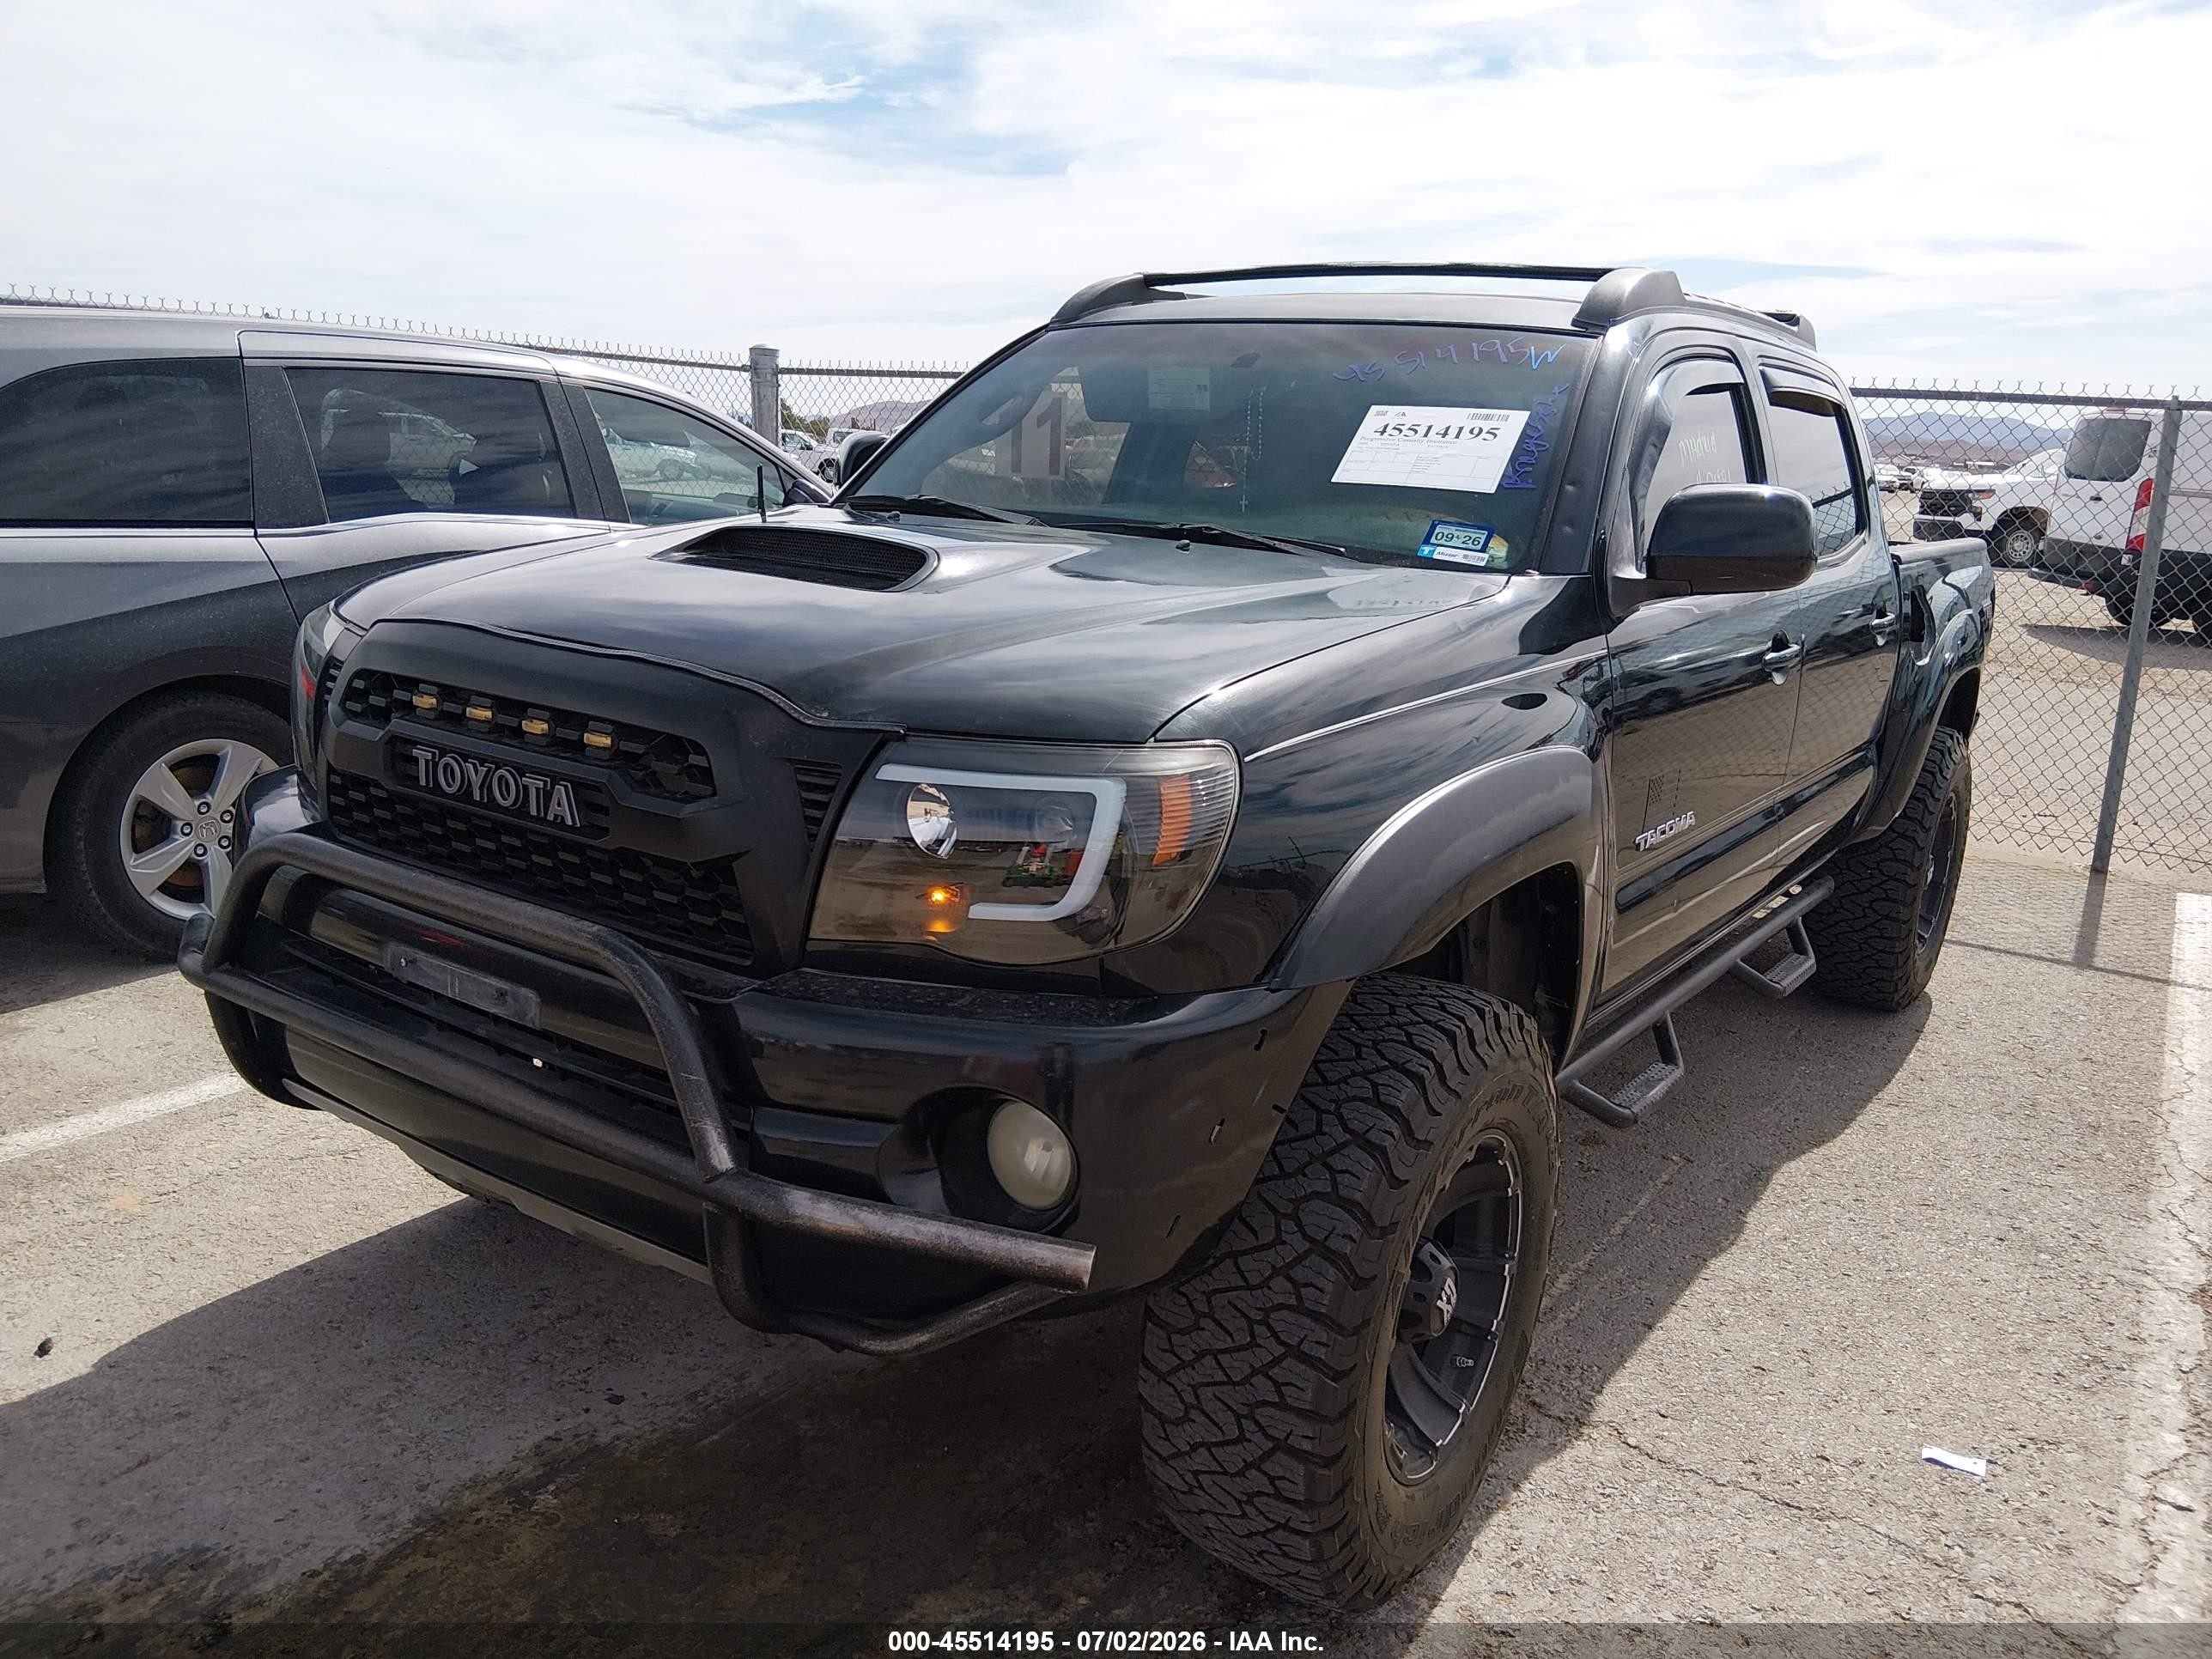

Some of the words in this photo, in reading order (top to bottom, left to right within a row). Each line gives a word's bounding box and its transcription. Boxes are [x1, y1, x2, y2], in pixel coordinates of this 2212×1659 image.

[1373, 422, 1501, 441] 45514195
[1434, 531, 1455, 543] 09
[1462, 535, 1482, 547] 26
[411, 745, 583, 828] TOYOTA
[1634, 811, 1697, 853] TACOMA
